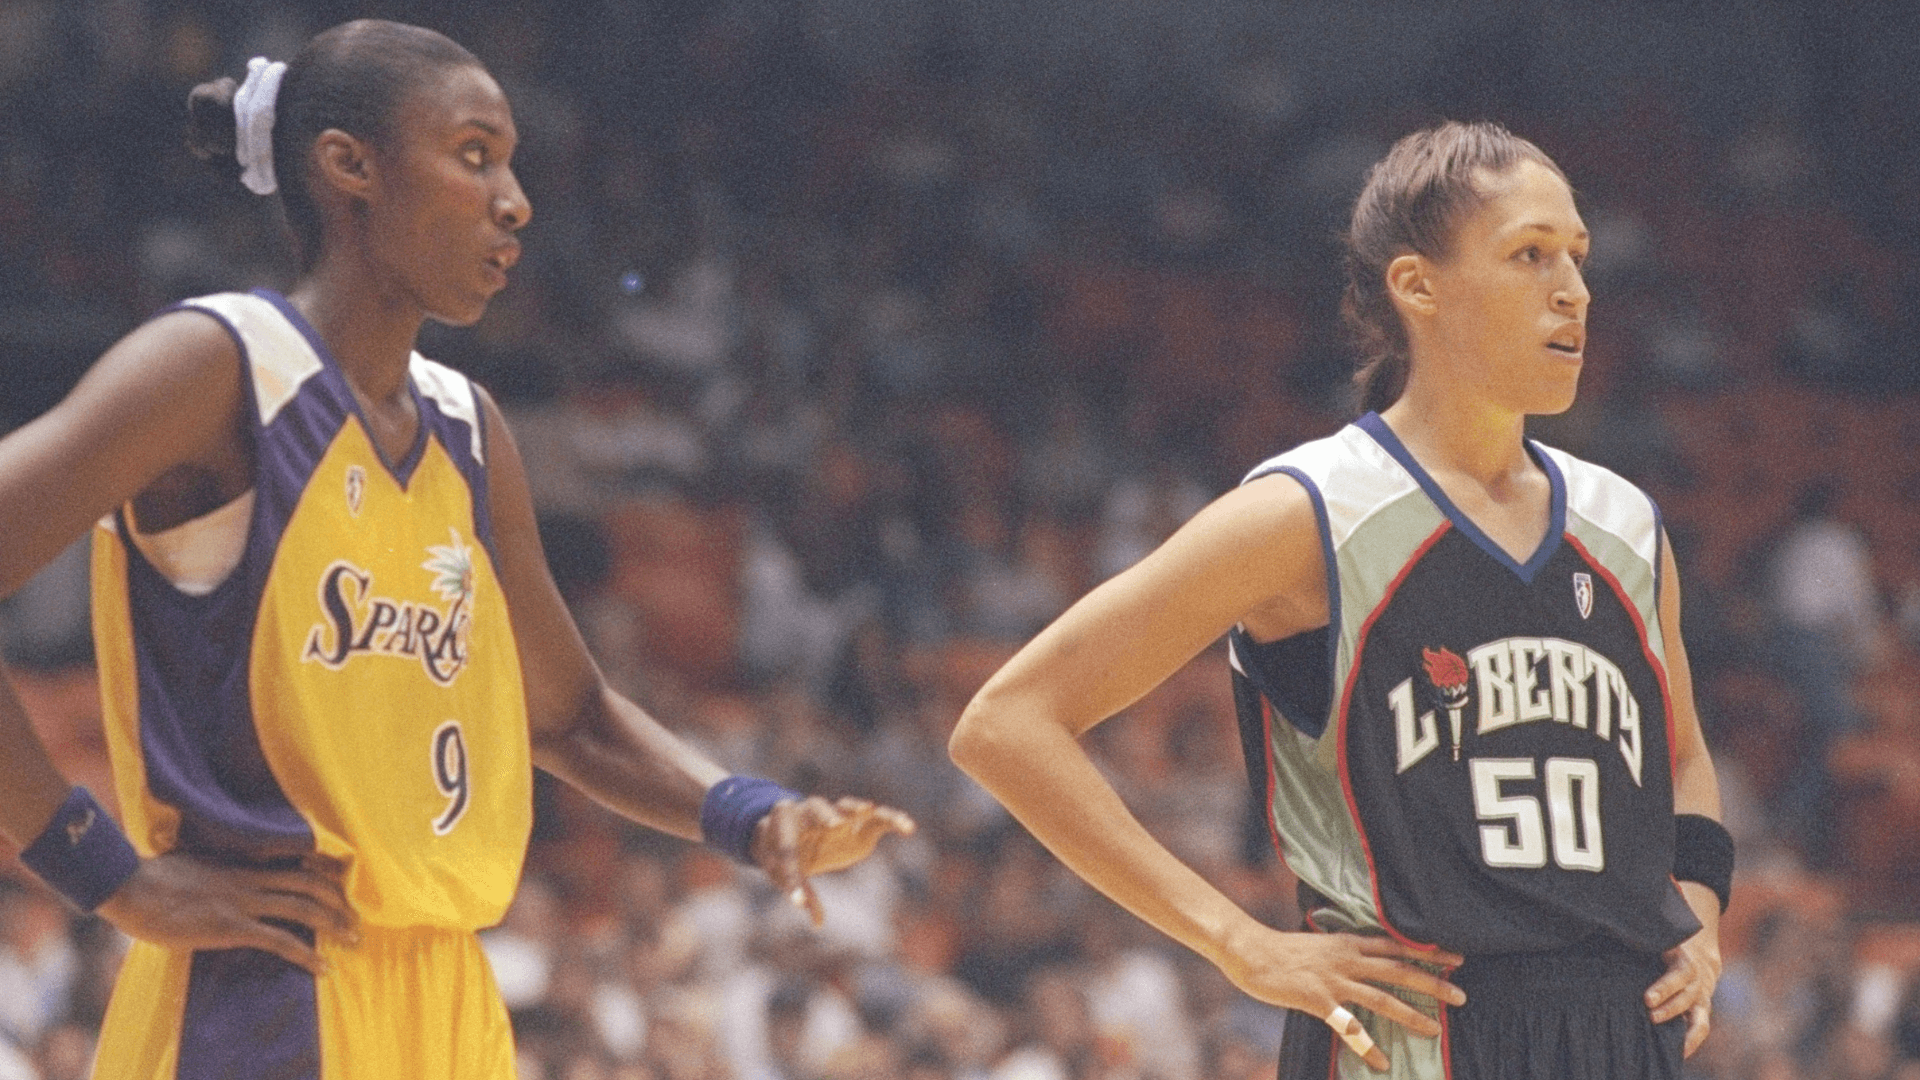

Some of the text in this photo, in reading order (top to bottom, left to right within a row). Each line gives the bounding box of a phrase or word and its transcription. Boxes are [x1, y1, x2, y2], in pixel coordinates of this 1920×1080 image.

[302, 561, 469, 686] SPARK
[1388, 636, 1643, 788] LIBERTY
[432, 722, 469, 836] 9
[1469, 757, 1604, 872] 50
